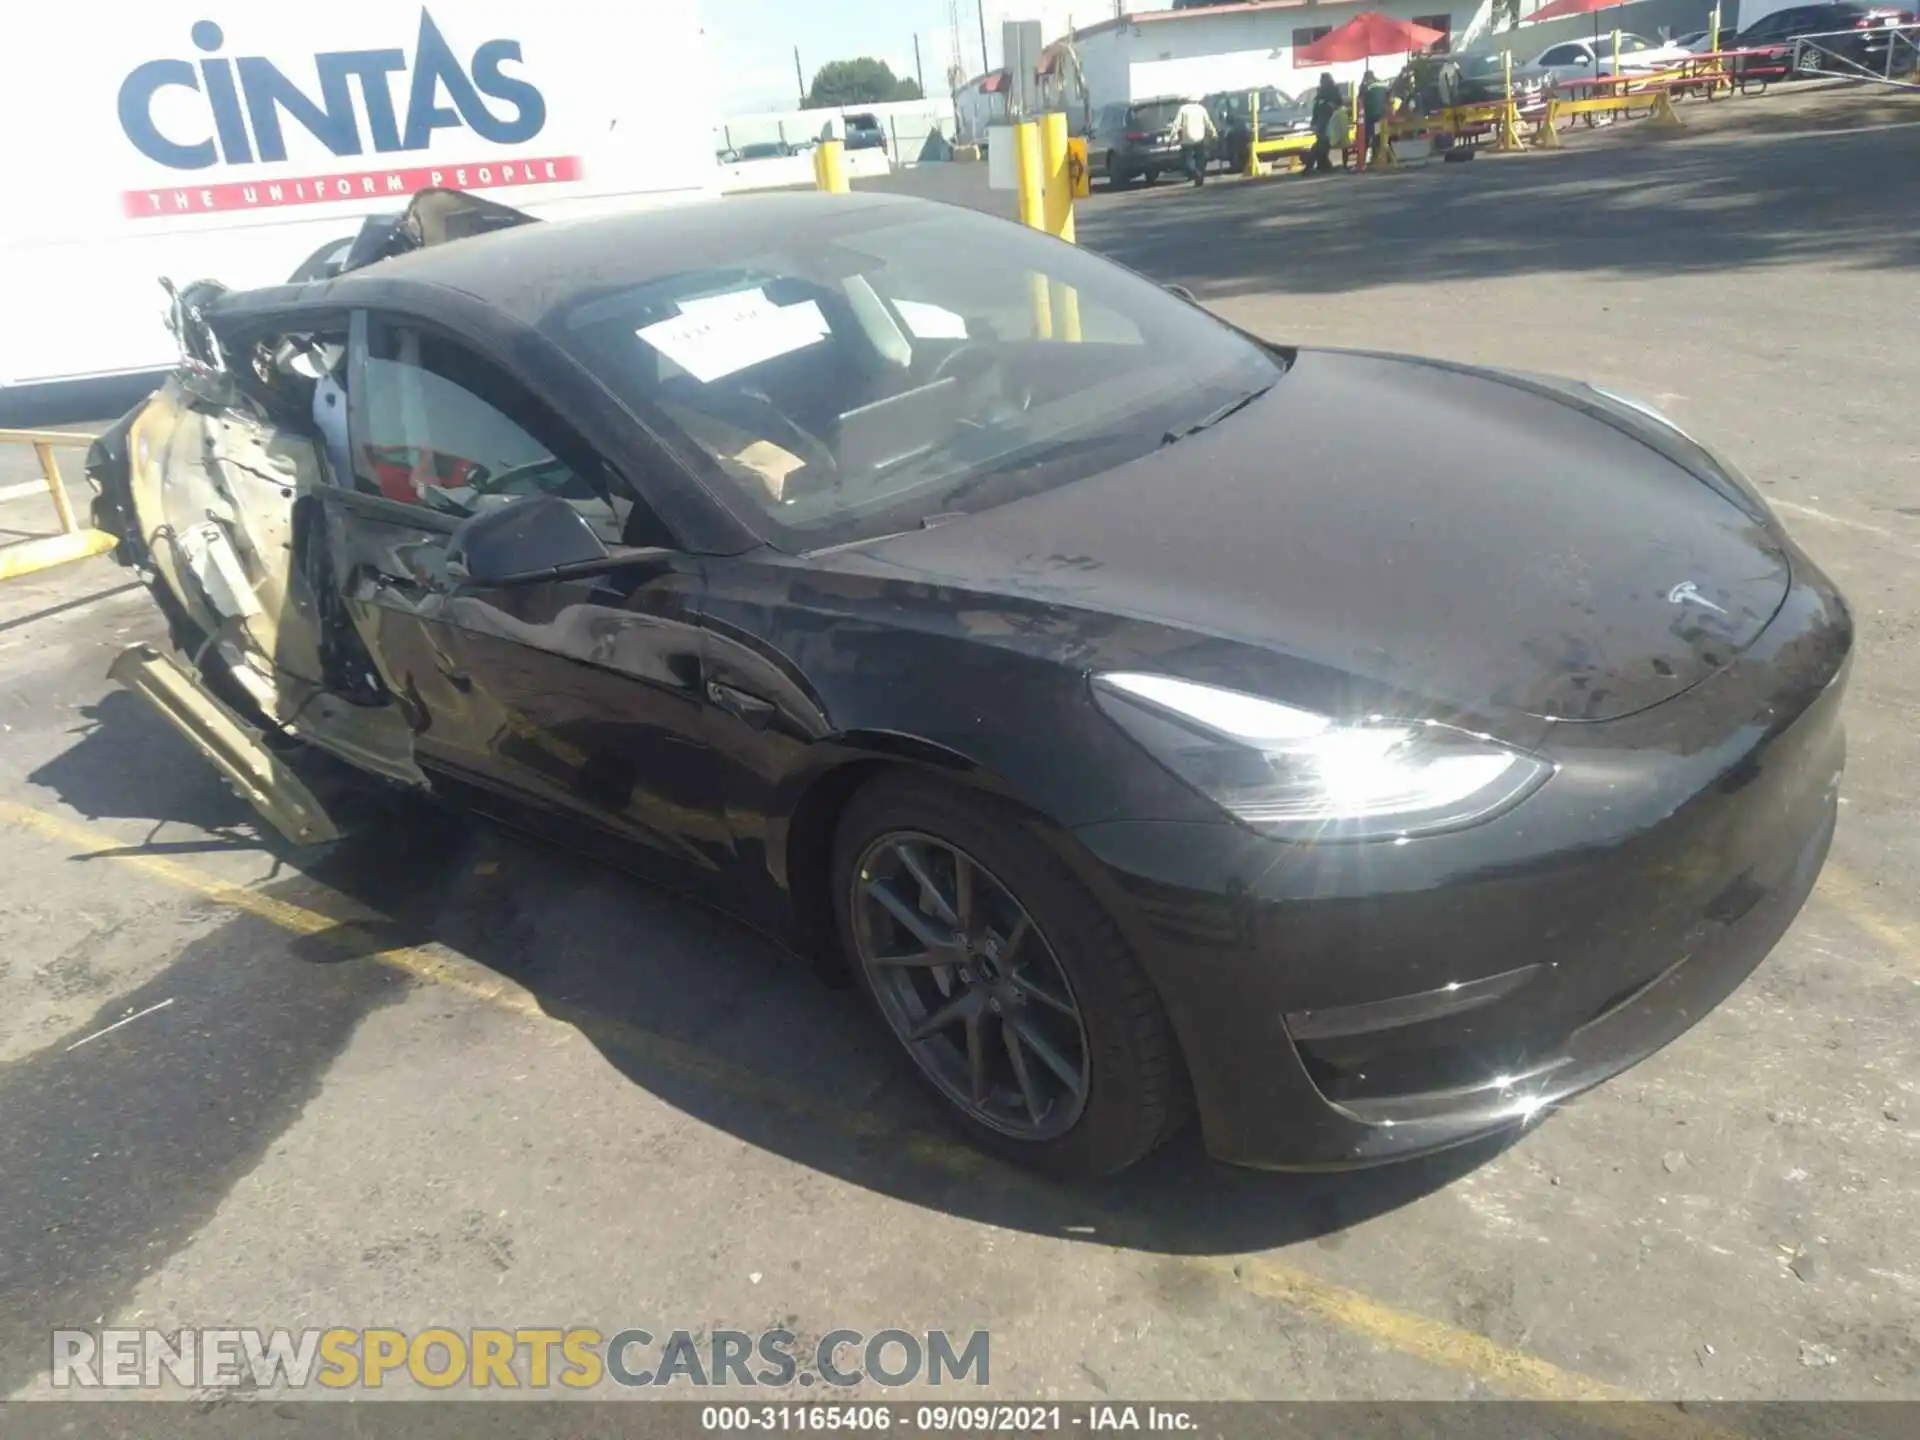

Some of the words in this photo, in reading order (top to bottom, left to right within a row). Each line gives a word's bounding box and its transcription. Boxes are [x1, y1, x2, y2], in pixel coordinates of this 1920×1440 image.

[148, 190, 214, 210] THE
[245, 173, 405, 205] UNIFORM
[431, 160, 558, 189] PEOPLE
